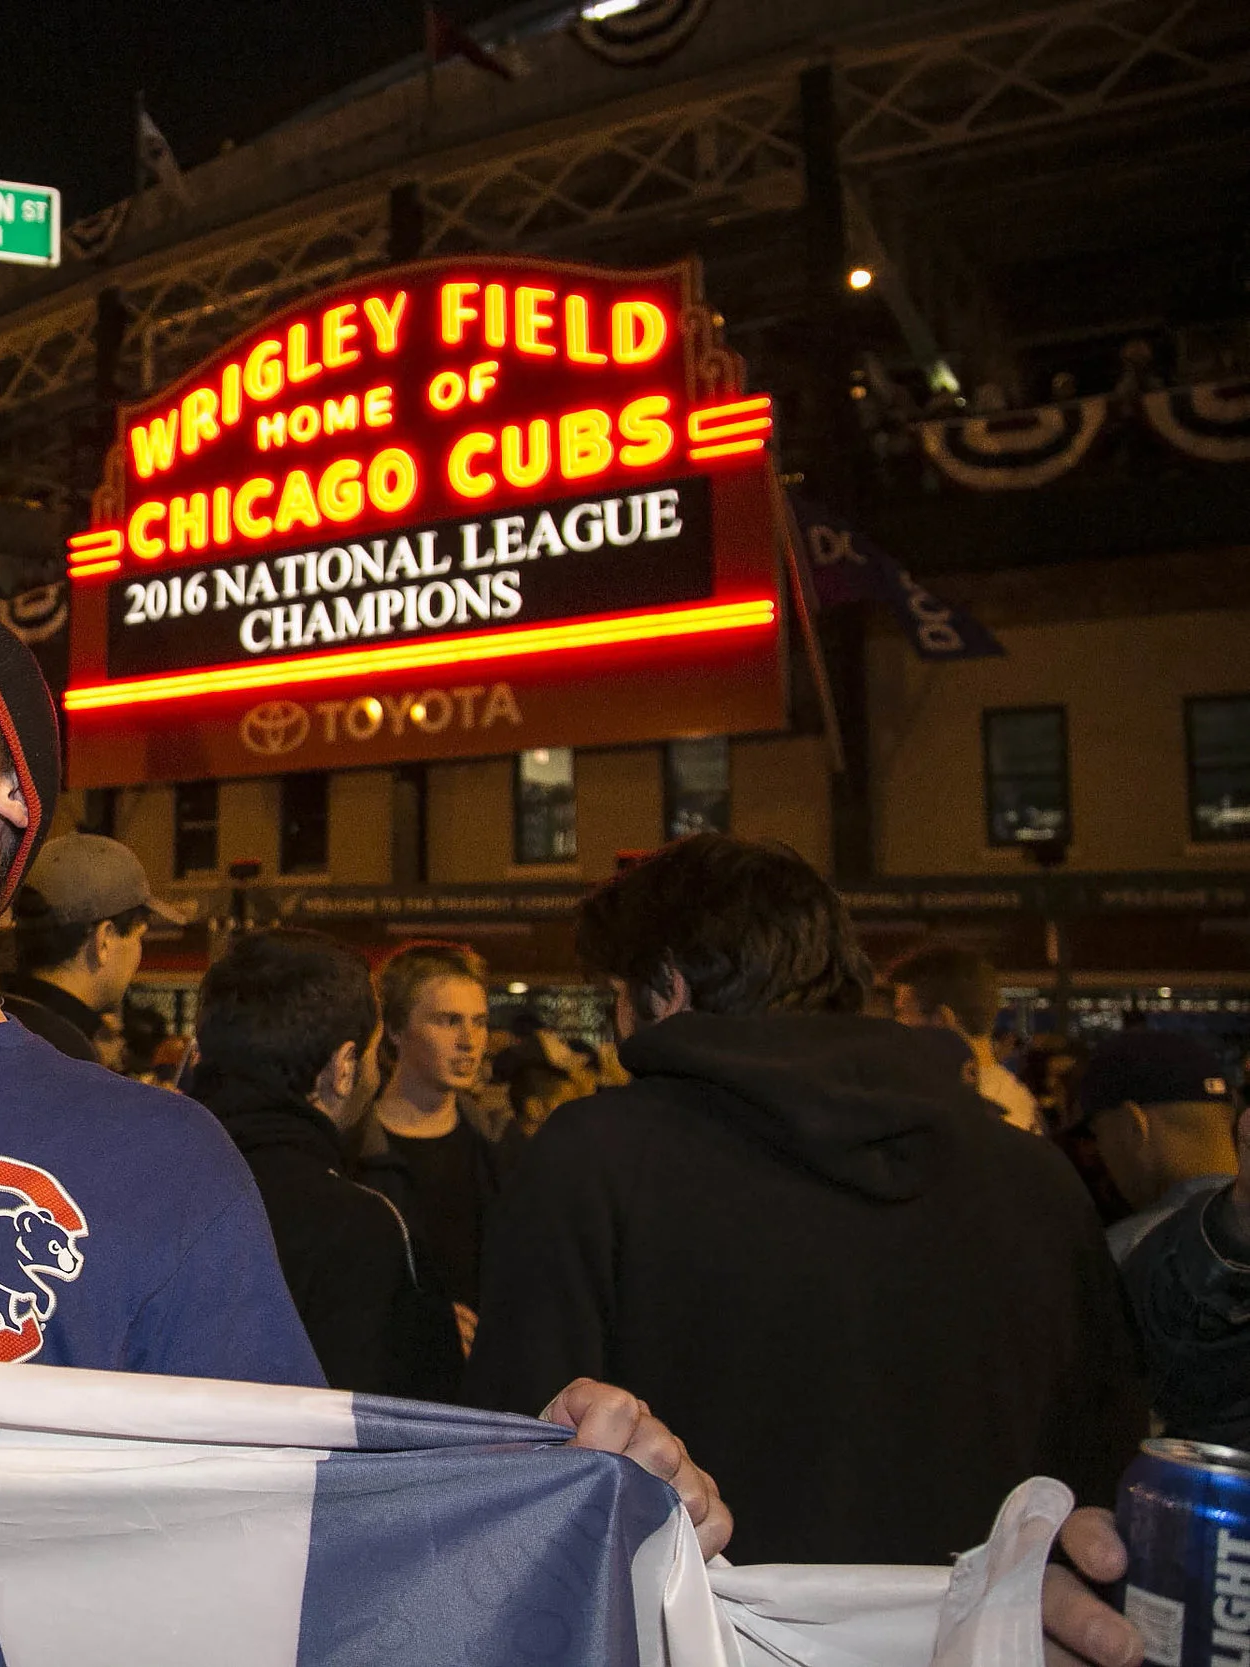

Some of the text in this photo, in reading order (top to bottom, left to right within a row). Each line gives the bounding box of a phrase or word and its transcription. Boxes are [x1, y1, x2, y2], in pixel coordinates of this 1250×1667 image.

[21, 199, 48, 223] ST
[130, 282, 667, 478] WRIGLEY FIELD
[256, 360, 499, 451] HOME OF
[128, 395, 674, 559] CHICAGO CUBS
[123, 489, 684, 625] 2016 NATIONAL LEAGUE
[239, 570, 523, 653] CHAMPIONS
[315, 682, 524, 743] TOYOTA
